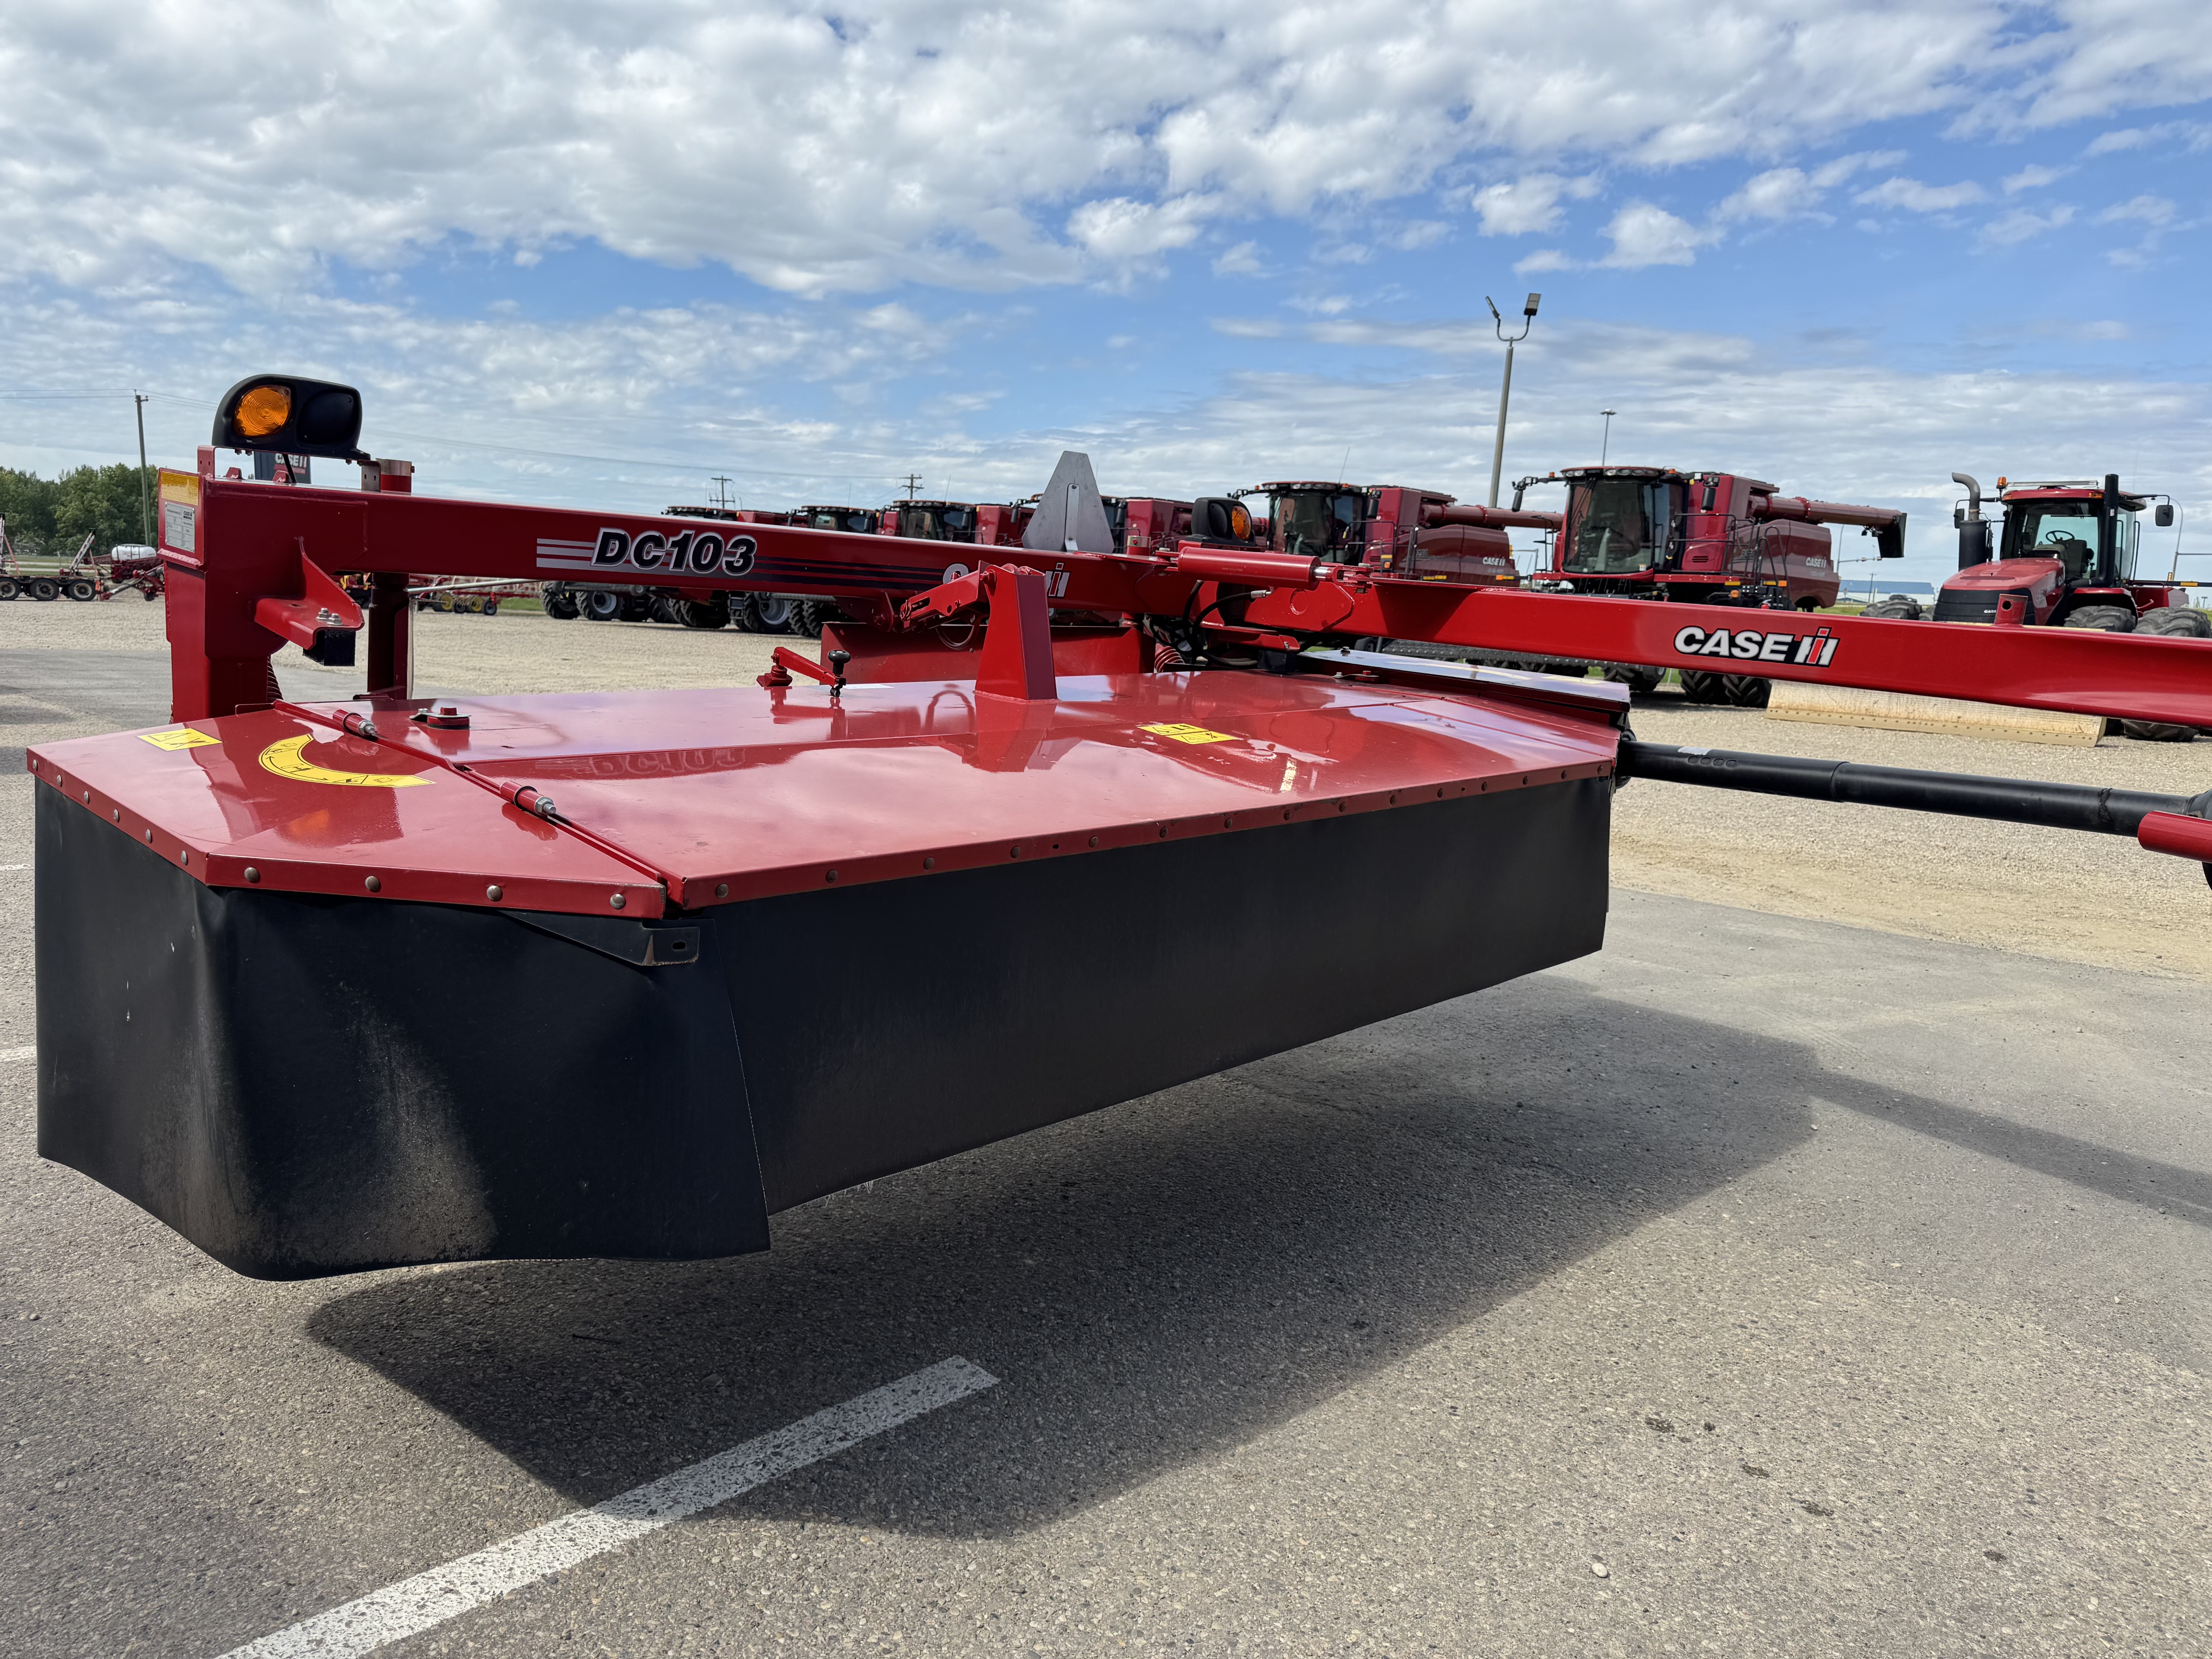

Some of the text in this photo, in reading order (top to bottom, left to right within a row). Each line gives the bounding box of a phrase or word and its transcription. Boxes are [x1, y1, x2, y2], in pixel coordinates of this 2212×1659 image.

[591, 527, 757, 576] DC103
[1483, 556, 1499, 565] CASE
[1806, 557, 1822, 567] CASE
[1674, 626, 1794, 661] CASE
